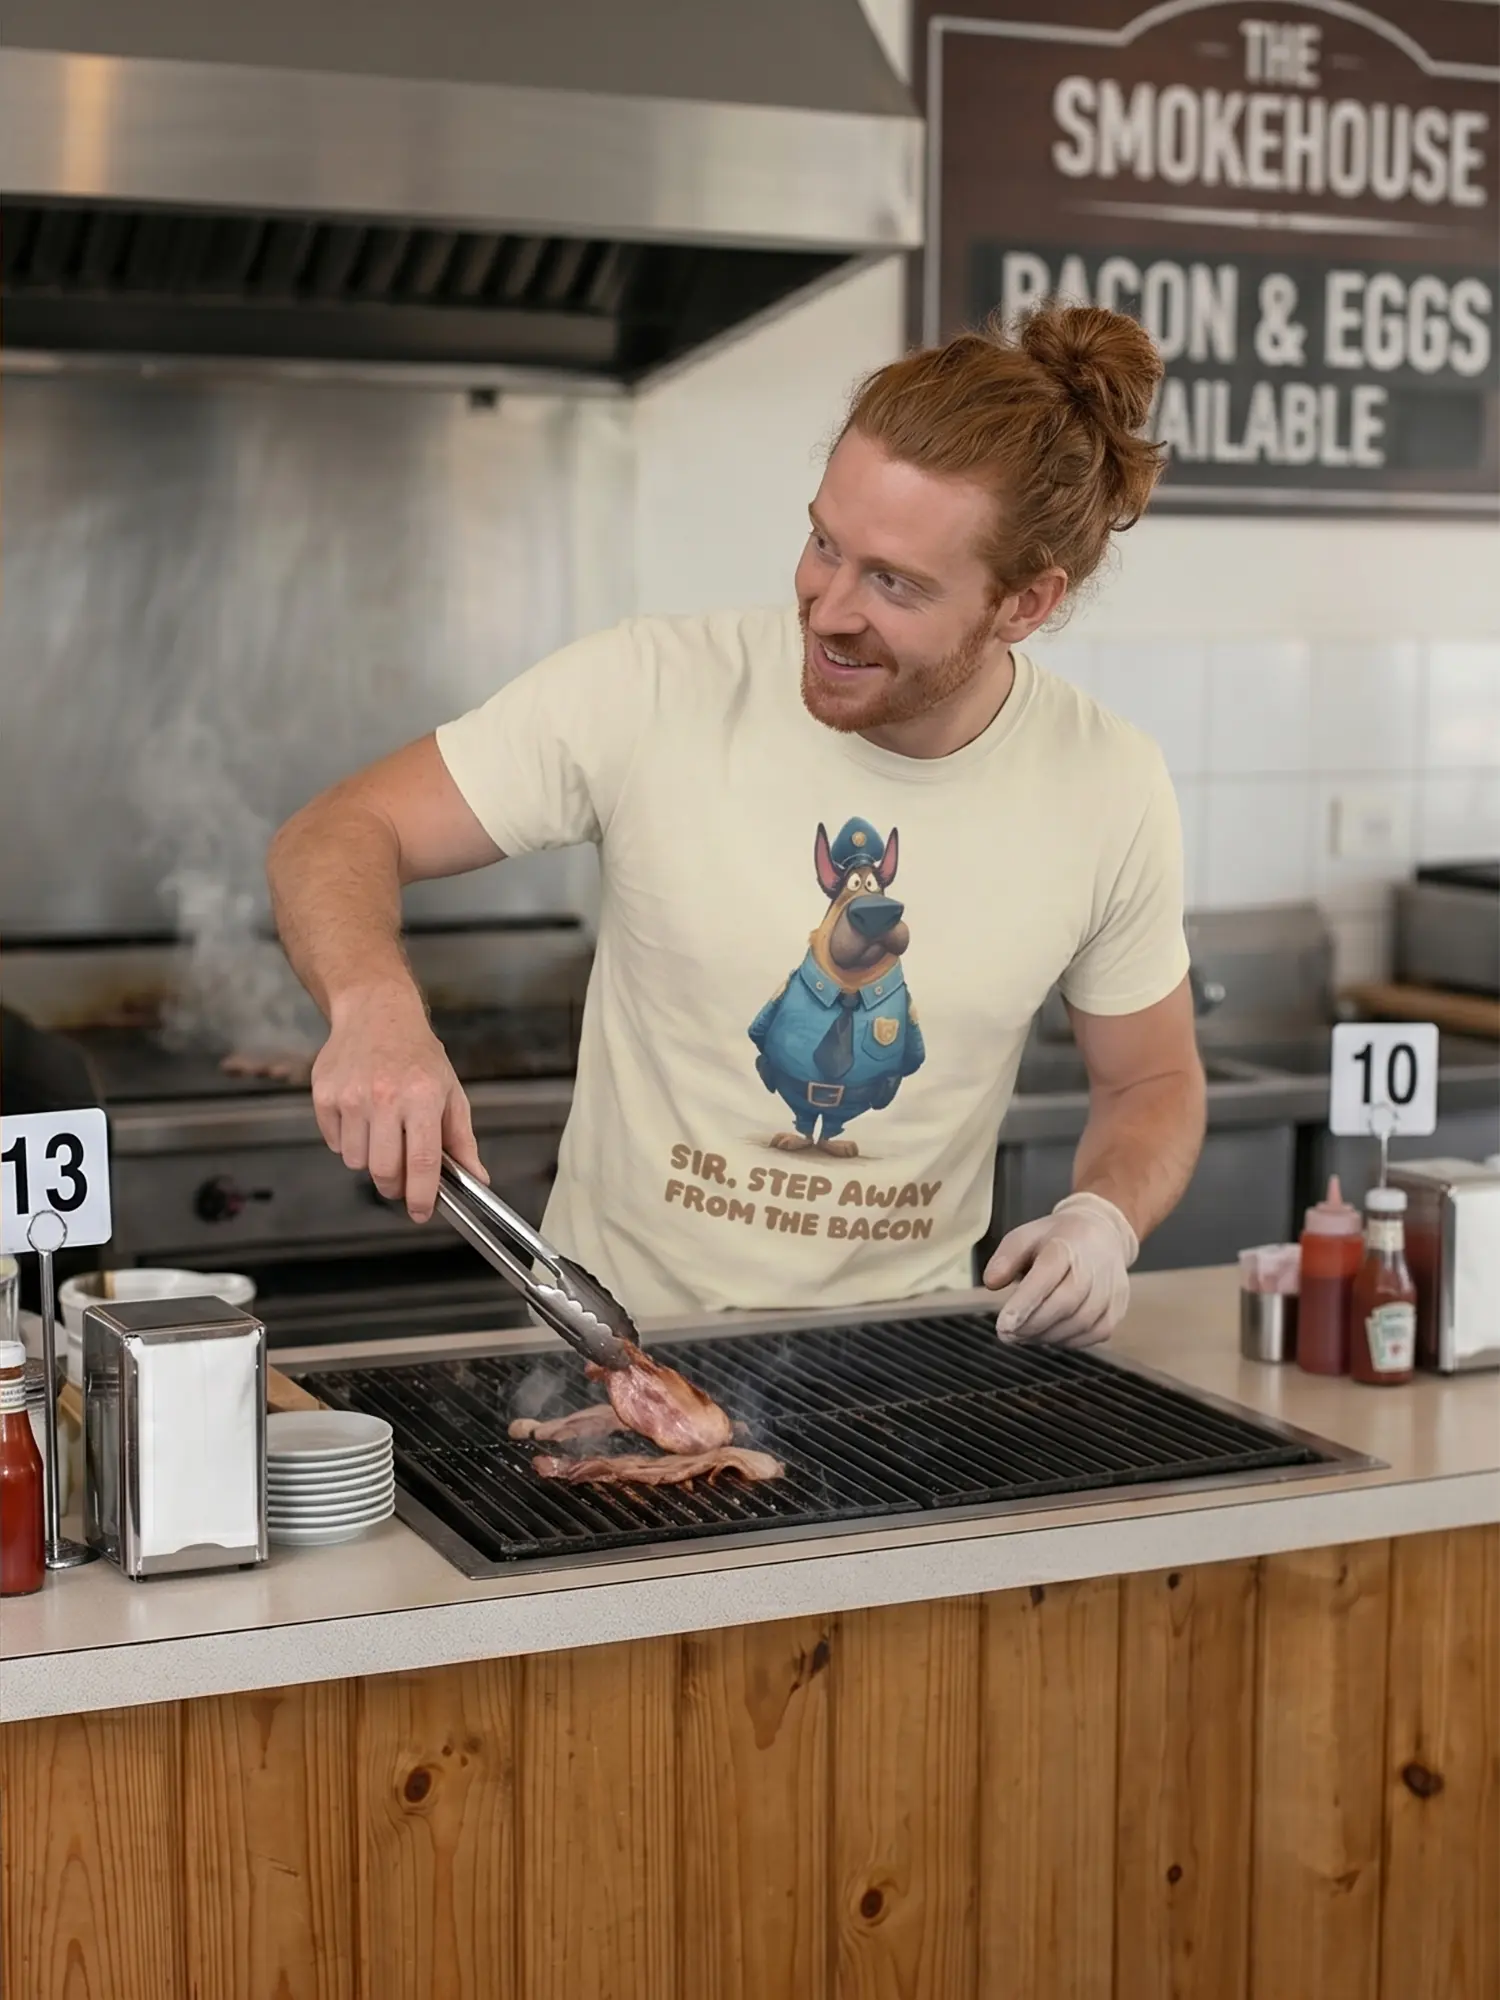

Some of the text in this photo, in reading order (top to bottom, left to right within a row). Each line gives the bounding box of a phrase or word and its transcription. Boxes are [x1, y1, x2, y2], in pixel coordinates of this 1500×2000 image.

[1240, 20, 1321, 88] THE
[1052, 76, 1488, 206] SMOKEHOUSE
[1256, 274, 1306, 366] &
[1325, 271, 1493, 376] EGGS
[1148, 377, 1387, 468] AILABLE
[1353, 1043, 1417, 1104] 10
[1, 1132, 88, 1214] 13
[664, 1179, 933, 1241] FROM THE BACON
[670, 1143, 942, 1208] SIR. STEP AWAY
